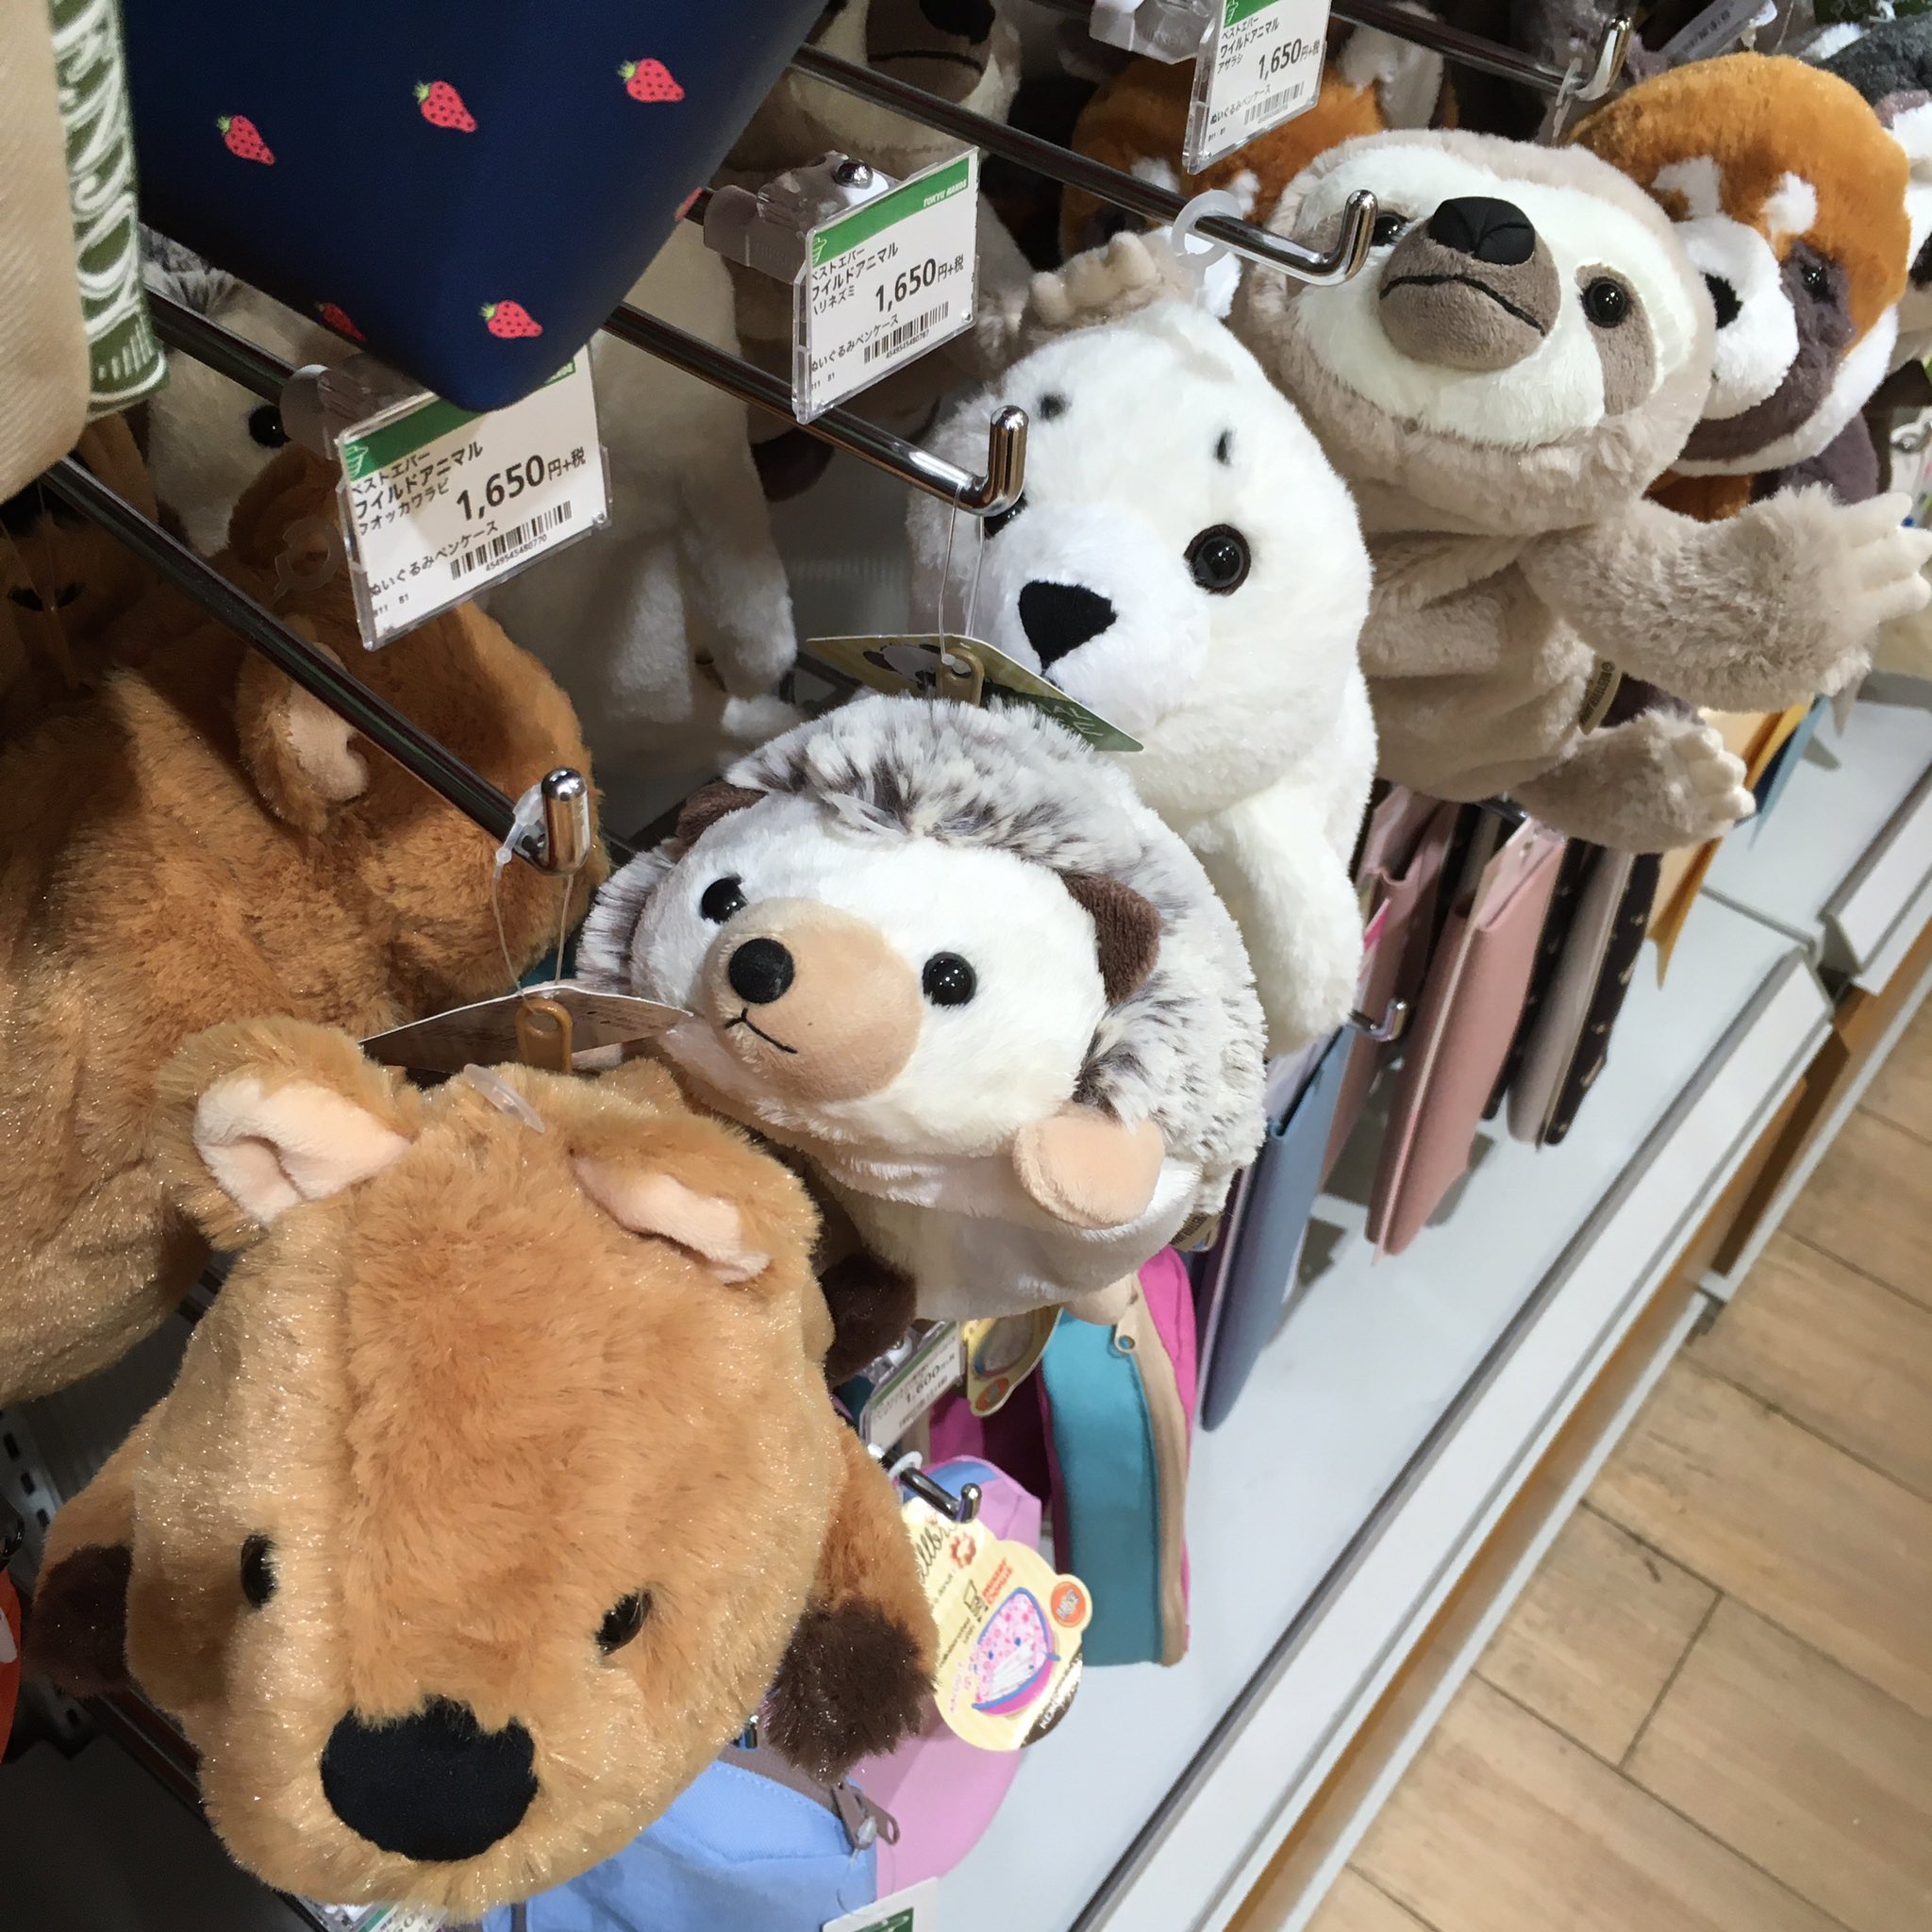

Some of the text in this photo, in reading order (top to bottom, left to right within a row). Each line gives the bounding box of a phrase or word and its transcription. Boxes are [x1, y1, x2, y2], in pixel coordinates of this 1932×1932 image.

[1221, 17, 1279, 58] ワイルドアニマル
[1222, 17, 1259, 40] ベストエバー
[1217, 54, 1243, 75] アザラシ
[371, 520, 499, 598] ぬいぐるみペンケース
